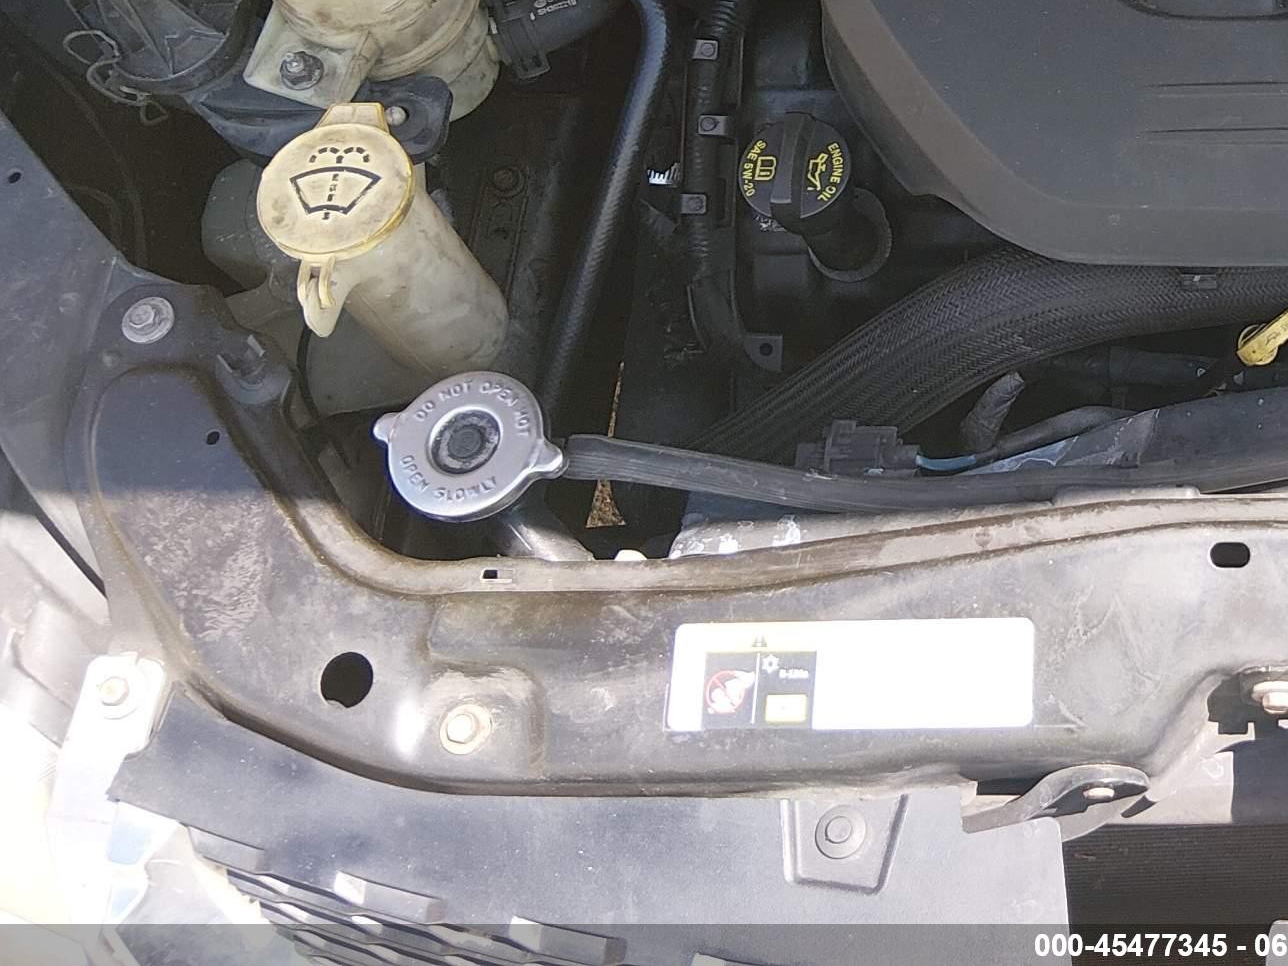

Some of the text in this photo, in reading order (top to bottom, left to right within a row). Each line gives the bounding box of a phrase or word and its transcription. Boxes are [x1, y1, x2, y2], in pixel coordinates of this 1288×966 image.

[742, 139, 767, 198] SAE 5W-20
[817, 142, 845, 203] ENGINE OIL
[415, 380, 530, 438] DO NOT OPEN HOT
[400, 454, 498, 502] OPEN SLOWLY
